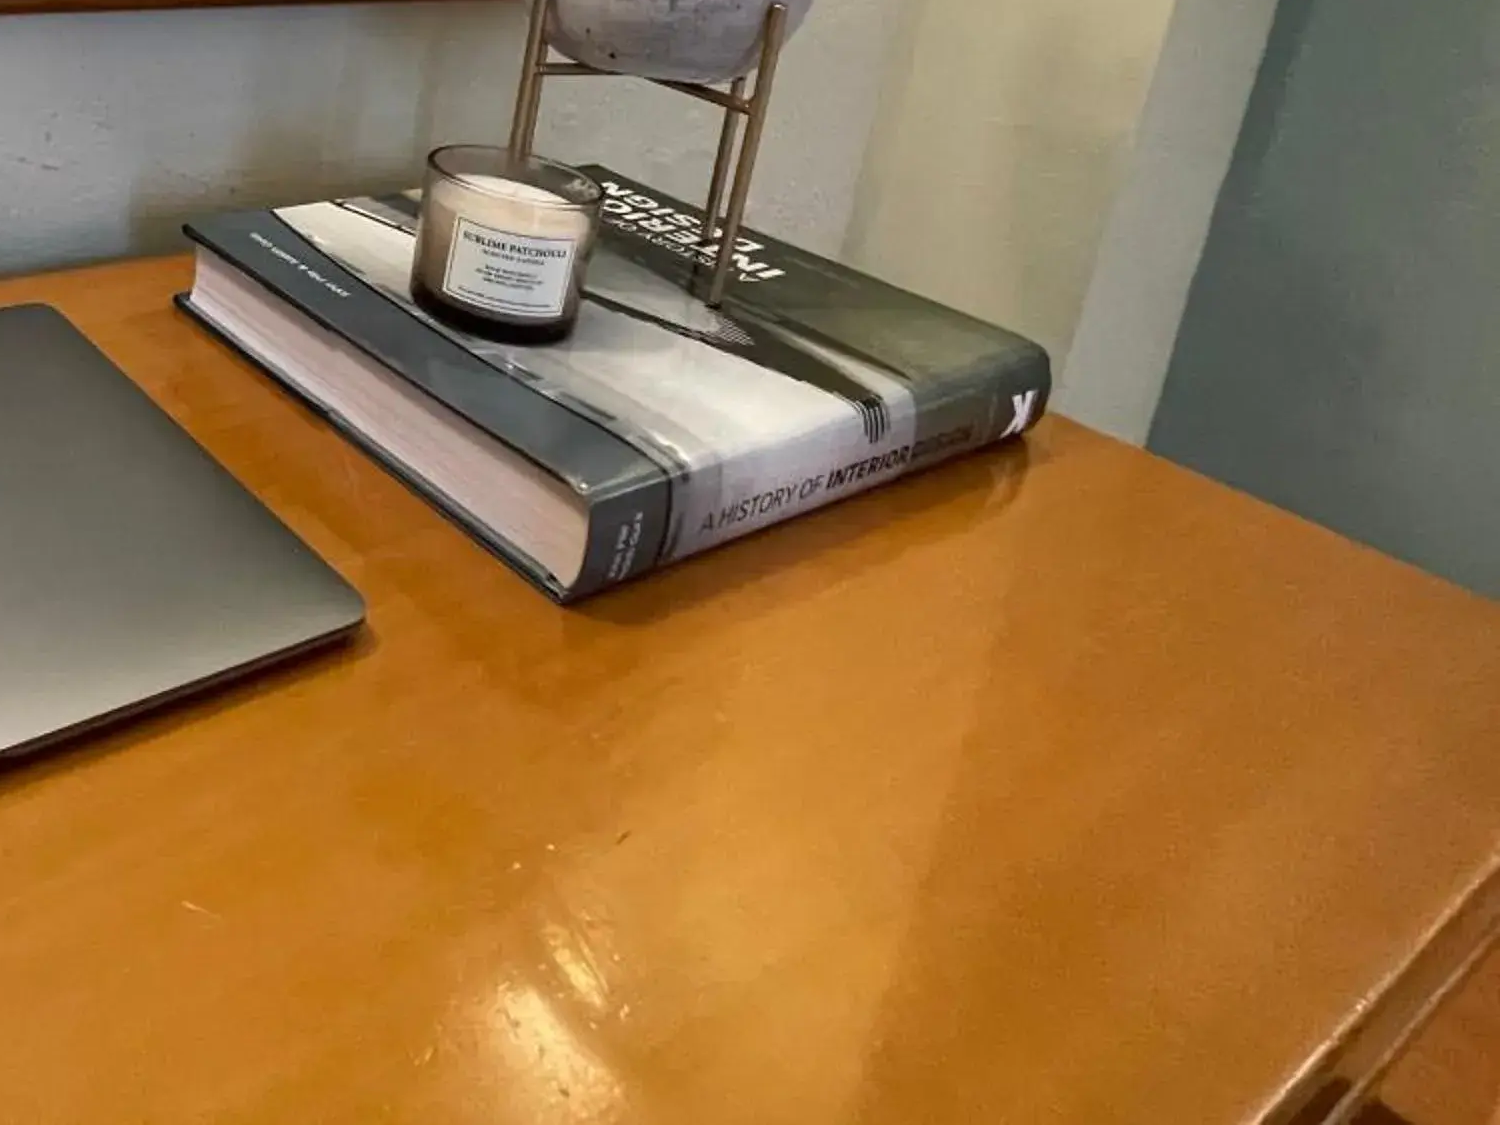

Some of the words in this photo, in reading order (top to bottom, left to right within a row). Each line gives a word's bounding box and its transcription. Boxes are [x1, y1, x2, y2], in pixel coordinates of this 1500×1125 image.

[462, 230, 507, 251] SUBLIME
[509, 244, 567, 259] PATCHOULI
[603, 199, 786, 279] INTERIO
[696, 511, 714, 534] A
[718, 483, 798, 530] HISTORY
[799, 474, 825, 500] OF
[825, 445, 912, 490] INTERIOR
